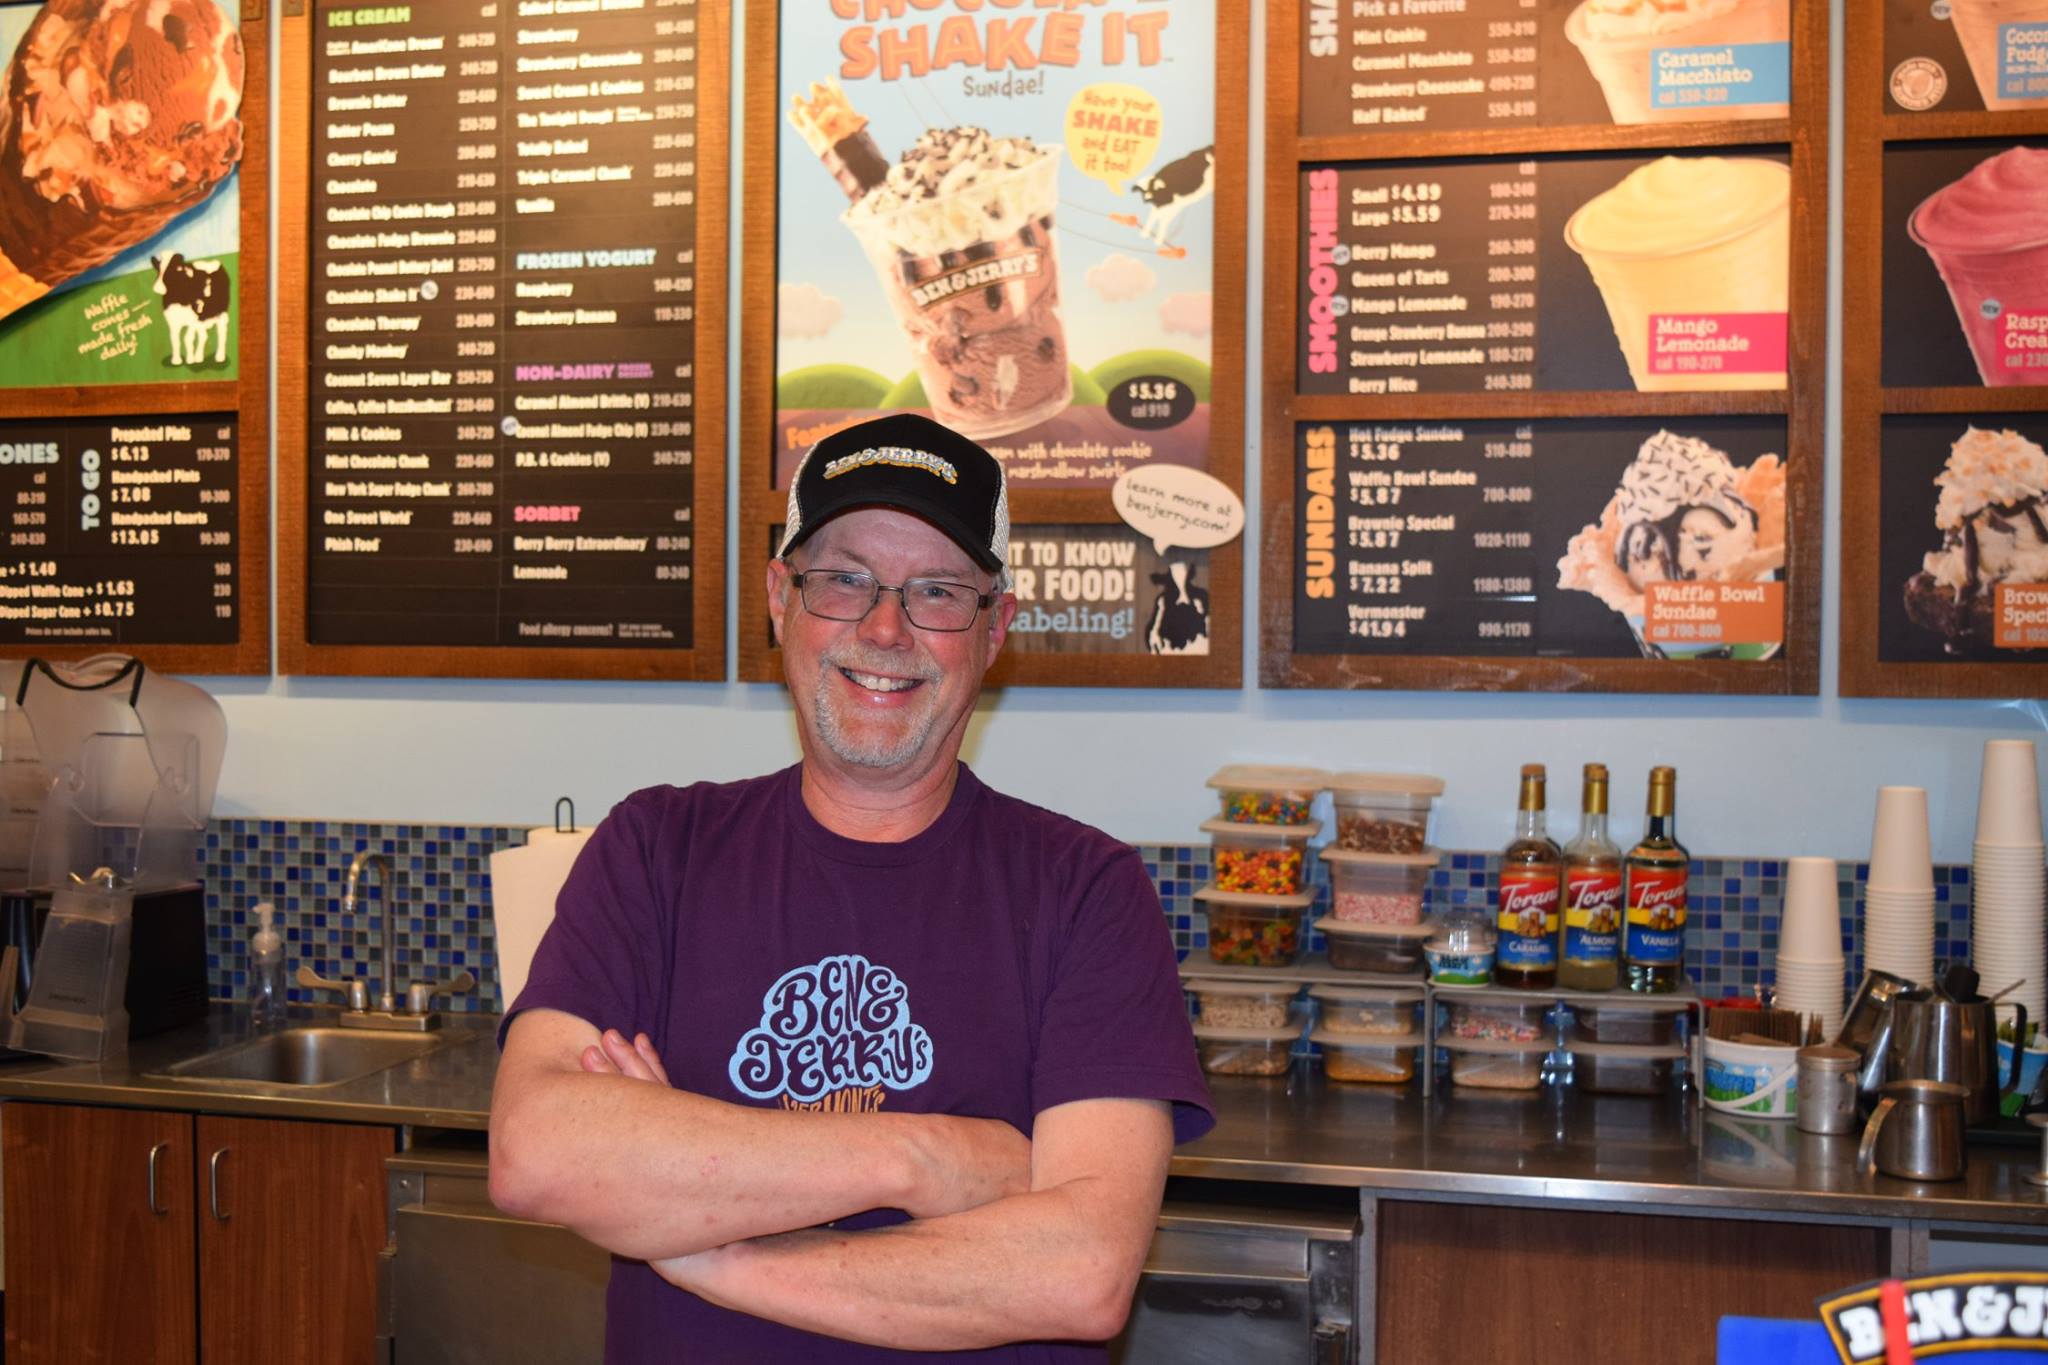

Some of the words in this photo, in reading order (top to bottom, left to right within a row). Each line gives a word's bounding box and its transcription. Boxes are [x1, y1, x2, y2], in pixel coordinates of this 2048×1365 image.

[328, 11, 353, 27] ICE
[355, 7, 411, 25] CREAM
[1353, 1, 1386, 18] Pick
[1388, 1, 1399, 15] a
[1403, 0, 1467, 14] Favorite
[839, 11, 1085, 81] SHAKE
[1102, 11, 1168, 66] IT
[1352, 54, 1406, 71] Caramel
[1408, 52, 1474, 68] Macchiato
[1658, 48, 1733, 68] Caramel
[2006, 45, 2048, 65] Fudg
[1659, 67, 1752, 86] Macchiato
[963, 71, 1044, 100] Sundae!
[1351, 83, 1415, 99] Strawberry
[1072, 110, 1159, 138] SHAKE
[1112, 138, 1141, 155] EAT
[1352, 188, 1389, 204] Small
[1352, 211, 1390, 226] Large
[516, 252, 583, 270] FROZEN
[585, 248, 656, 267] YOGURT
[1352, 245, 1389, 260] Berry
[1390, 244, 1436, 259] Mango
[1309, 169, 1338, 373] SMOOTHIES
[1352, 272, 1395, 288] Queen
[1397, 270, 1412, 285] of
[1414, 269, 1449, 285] Tarts
[84, 293, 129, 320] Waffle
[1352, 299, 1396, 314] Mango
[1398, 295, 1467, 312] Lemonade
[91, 309, 130, 332] cones
[516, 310, 574, 326] Strawberry
[78, 331, 114, 354] made
[118, 315, 152, 340] fresh
[1656, 318, 1718, 338] Mango
[1656, 335, 1749, 352] Lemonade
[1350, 352, 1417, 367] Strawberry
[1419, 348, 1485, 365] Lemonade
[516, 364, 616, 381] NON-DAIRY
[1128, 382, 1177, 400] $5.36
[1349, 378, 1387, 394] Berry
[1131, 404, 1147, 418] cal
[1149, 403, 1171, 418] 910
[111, 427, 164, 442] Prepacked
[165, 426, 192, 441] Pints
[217, 426, 231, 440] cal
[1349, 428, 1372, 442] Hot
[1374, 428, 1413, 443] Fudge
[1415, 426, 1463, 441] Sundae
[1050, 442, 1109, 459] chocolate
[1111, 442, 1152, 459] cookie
[549, 453, 592, 467] Cookies
[34, 472, 47, 484] cal
[81, 449, 100, 491] GO
[111, 470, 172, 485] Handpacked
[174, 469, 201, 483] Pints
[1349, 472, 1391, 486] Waffle
[1394, 471, 1427, 486] Bowl
[1429, 470, 1476, 485] Sundae
[1126, 479, 1165, 499] learn
[1172, 492, 1210, 512] more
[1216, 503, 1232, 518] at
[81, 494, 100, 531] TO
[111, 512, 172, 526] Handpacked
[174, 511, 208, 525] Quarts
[514, 505, 581, 523] SORBET
[674, 507, 690, 523] cal
[1306, 425, 1336, 599] SUNDAES
[1348, 515, 1404, 531] Brownie
[1406, 515, 1455, 531] Special
[514, 536, 543, 551] Berry
[545, 536, 575, 551] Berry
[1030, 542, 1058, 566] TO
[1064, 542, 1136, 566] KNOW
[514, 565, 567, 580] Lemonade
[1349, 561, 1399, 575] Banana
[1401, 560, 1433, 576] Split
[31, 585, 61, 597] Waffle
[1044, 569, 1135, 601] FOOD!
[1654, 586, 1715, 602] Waffle
[1720, 586, 1765, 602] Bowl
[31, 606, 57, 619] Sugar
[1348, 605, 1425, 619] Vermonster
[1653, 604, 1718, 620] Sundae
[1008, 605, 1134, 639] abeling!
[1839, 1285, 2048, 1360] BN&J
